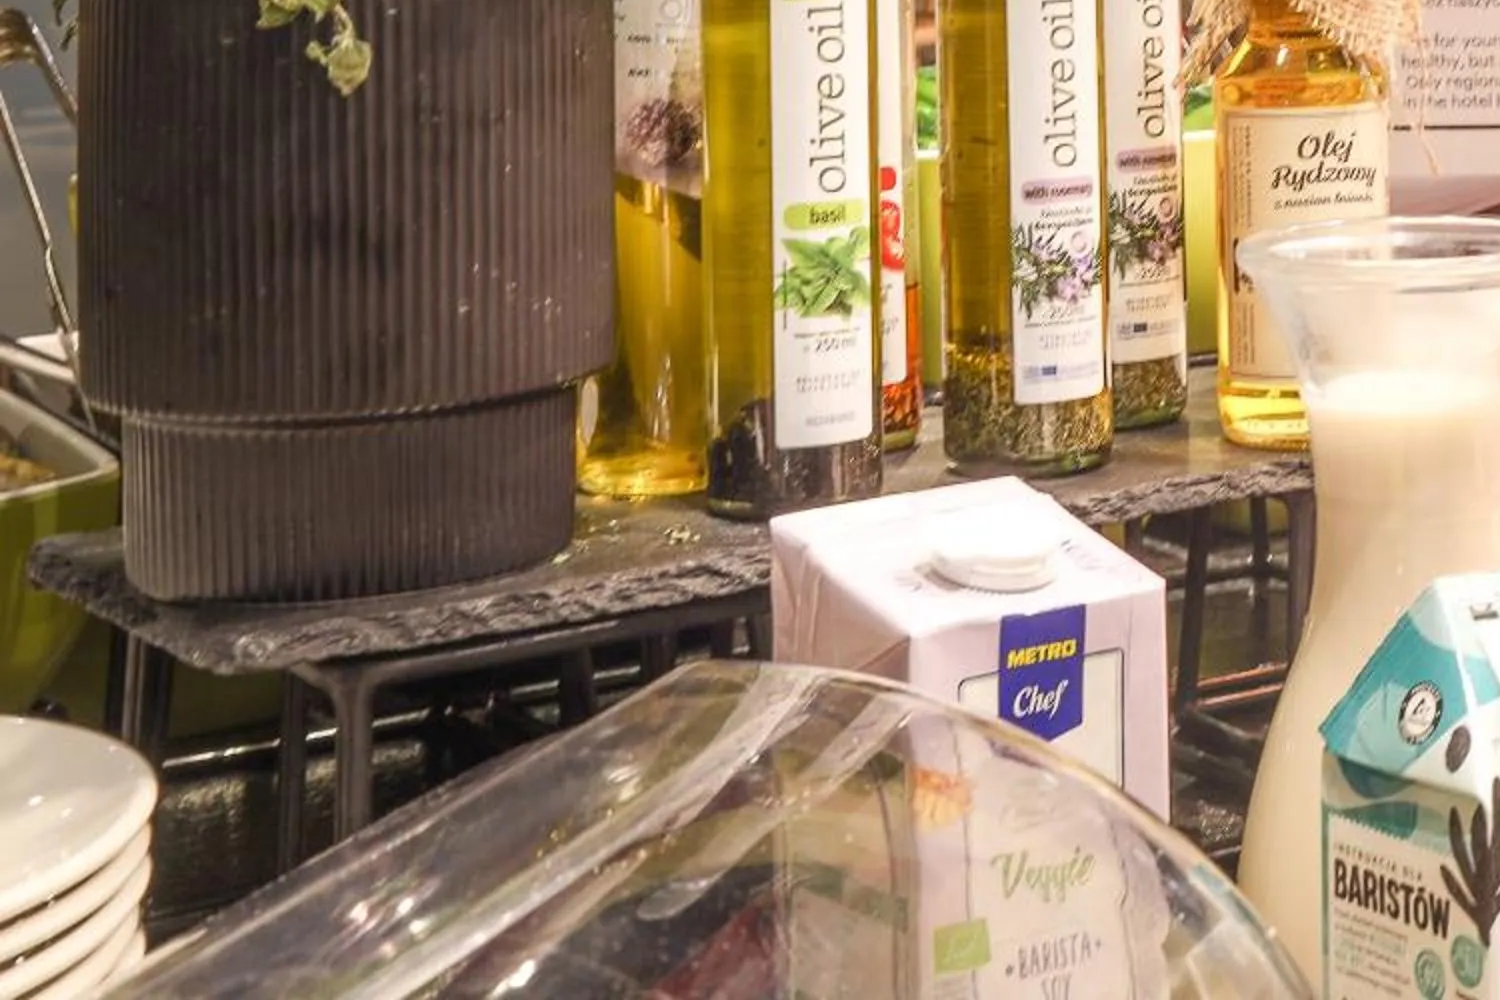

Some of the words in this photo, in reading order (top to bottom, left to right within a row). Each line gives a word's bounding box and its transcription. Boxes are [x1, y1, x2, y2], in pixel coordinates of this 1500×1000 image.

[807, 0, 846, 64] oil
[1434, 31, 1456, 47] for
[1469, 53, 1495, 68] but
[1137, 37, 1165, 139] olive
[1451, 93, 1493, 108] hotel
[1043, 58, 1078, 168] olive
[809, 72, 848, 194] olive
[1296, 130, 1357, 164] Olej
[1271, 160, 1377, 192] Rydzowy
[809, 205, 847, 225] basil
[1007, 639, 1077, 669] METRO
[1013, 679, 1069, 720] Chef
[990, 845, 1096, 902] Veggie
[1335, 858, 1450, 940] BARISTÓW
